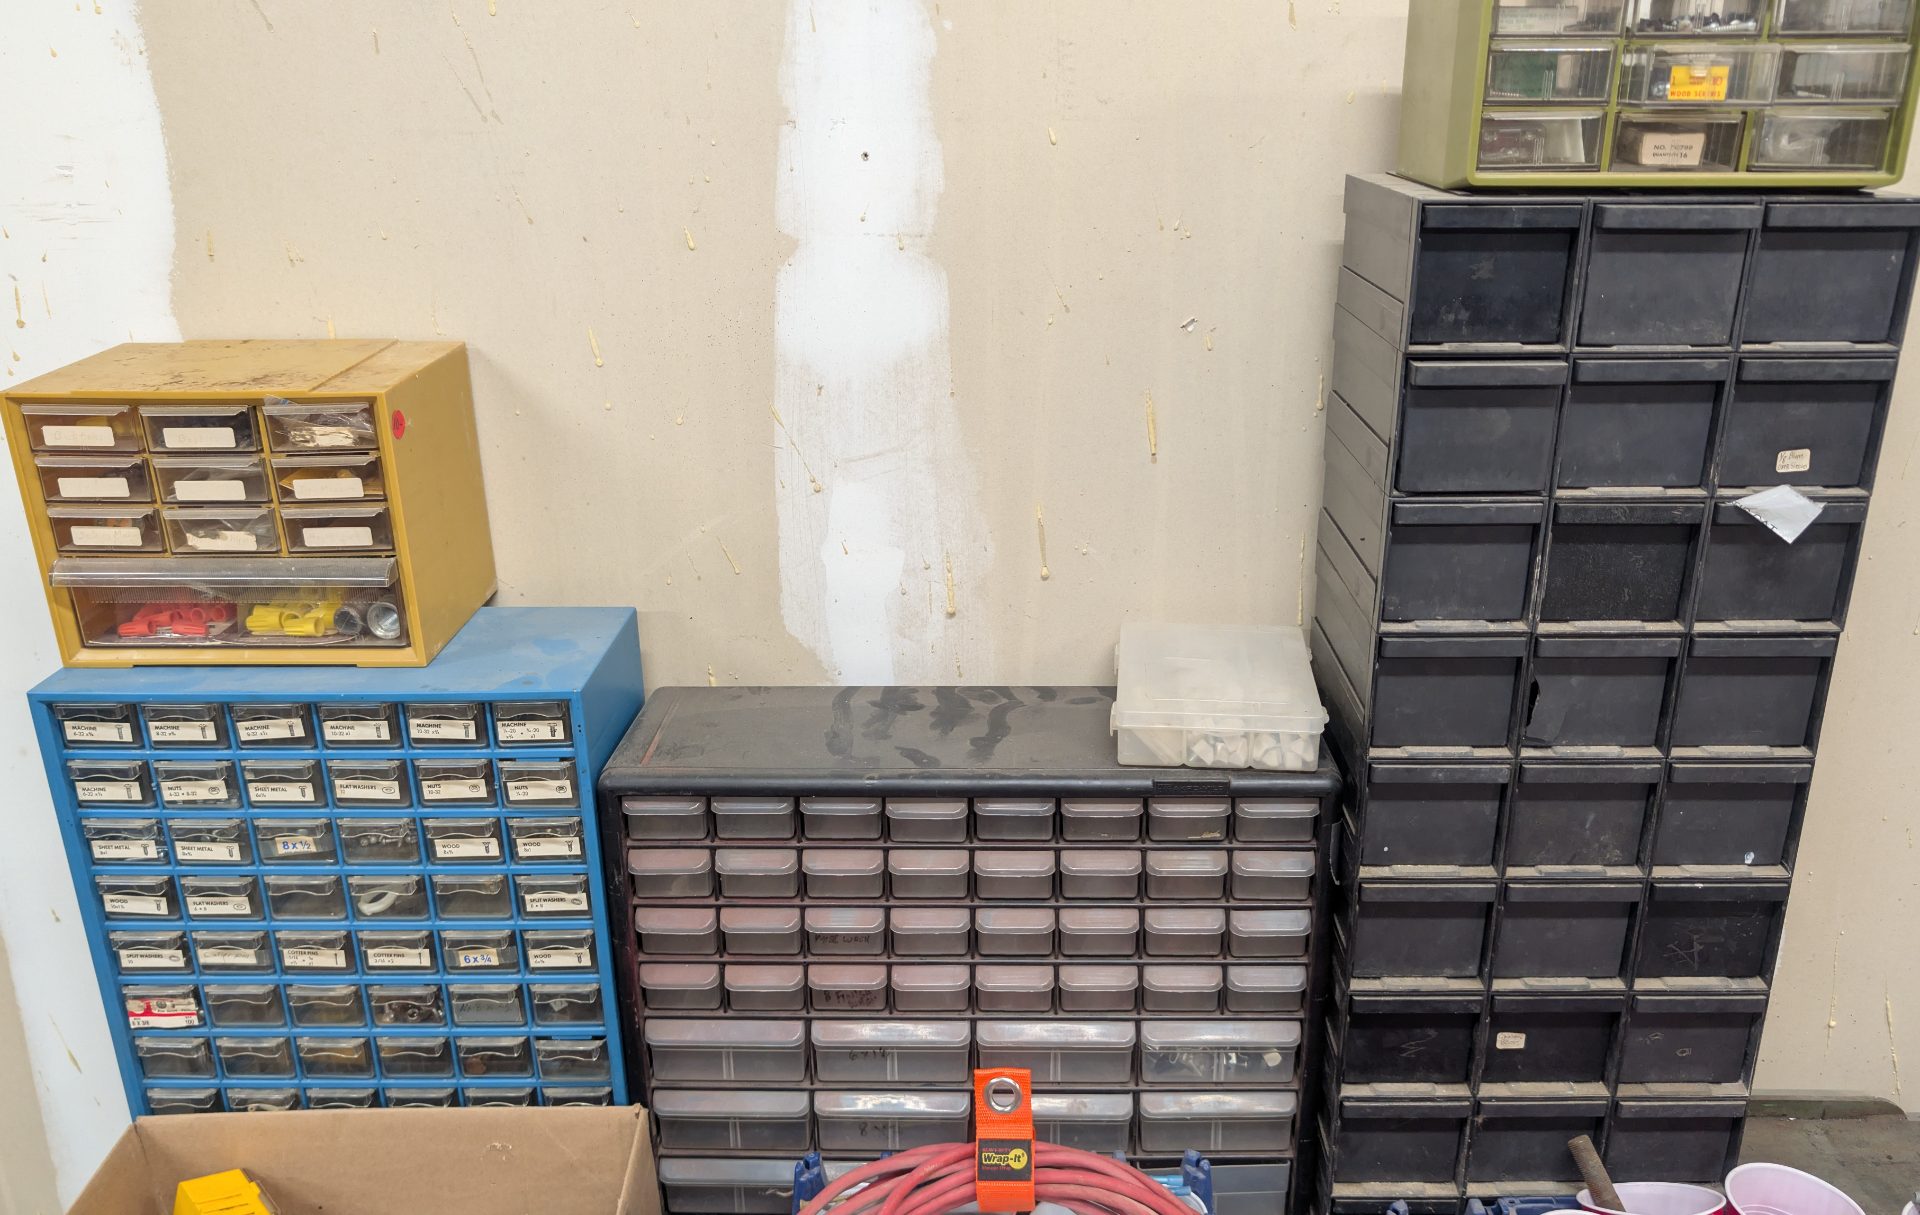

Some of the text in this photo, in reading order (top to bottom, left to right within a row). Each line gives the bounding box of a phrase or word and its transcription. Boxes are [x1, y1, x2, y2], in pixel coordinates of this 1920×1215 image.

[282, 841, 290, 850] 8
[463, 954, 471, 964] 6
[983, 1153, 1022, 1164] Wrap-It
